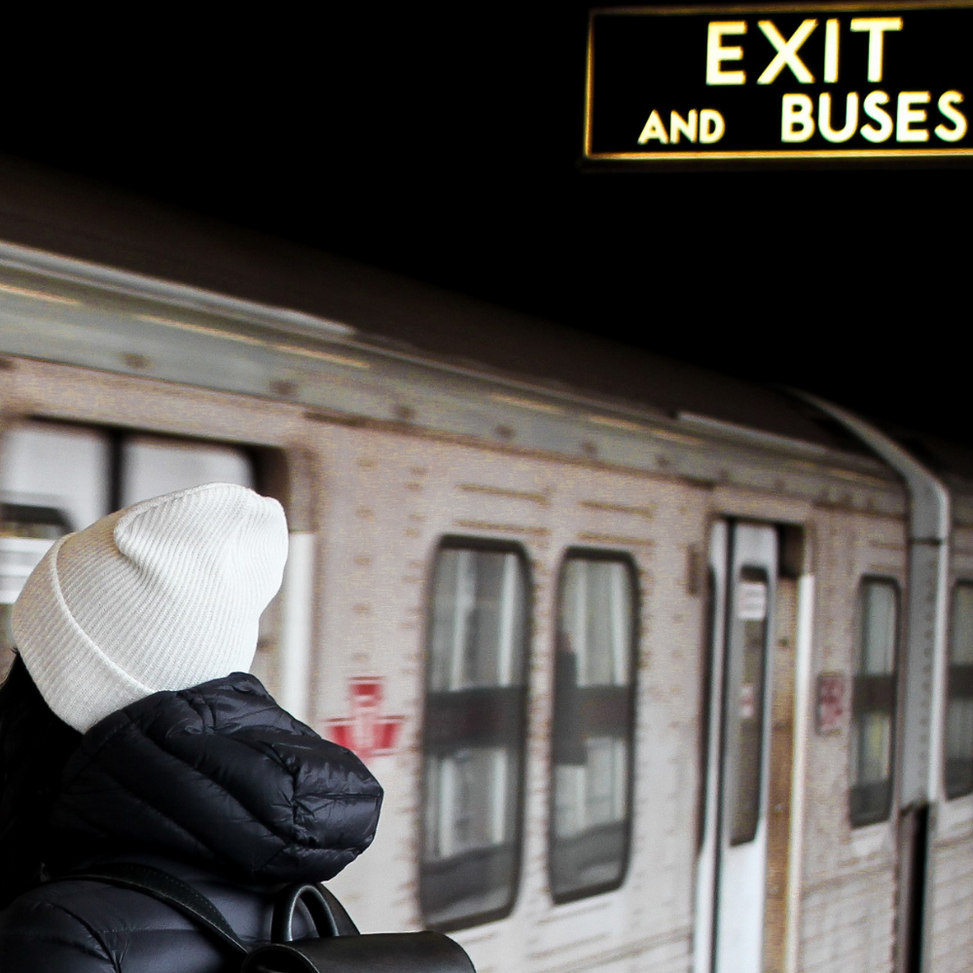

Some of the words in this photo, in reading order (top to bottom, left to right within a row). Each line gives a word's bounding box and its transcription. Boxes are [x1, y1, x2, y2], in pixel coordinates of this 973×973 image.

[705, 16, 904, 86] EXIT
[636, 108, 726, 145] AND
[780, 89, 969, 144] BUSES
